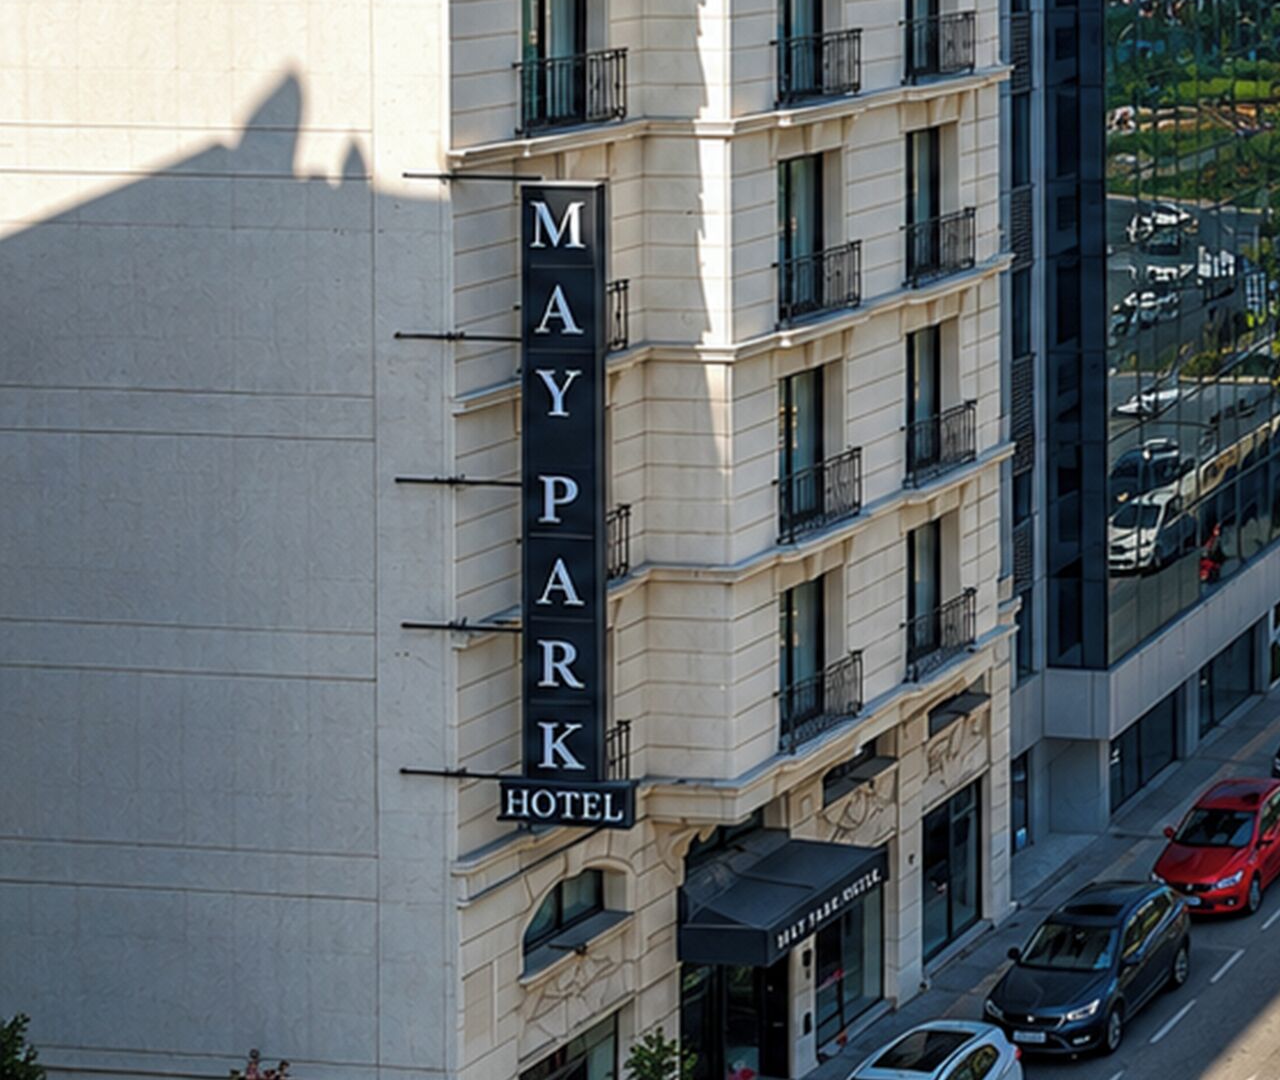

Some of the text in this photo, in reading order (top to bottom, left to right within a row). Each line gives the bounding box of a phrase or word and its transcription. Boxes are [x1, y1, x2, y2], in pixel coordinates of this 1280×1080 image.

[530, 201, 586, 771] MAY PARK
[506, 789, 623, 821] HOTEL
